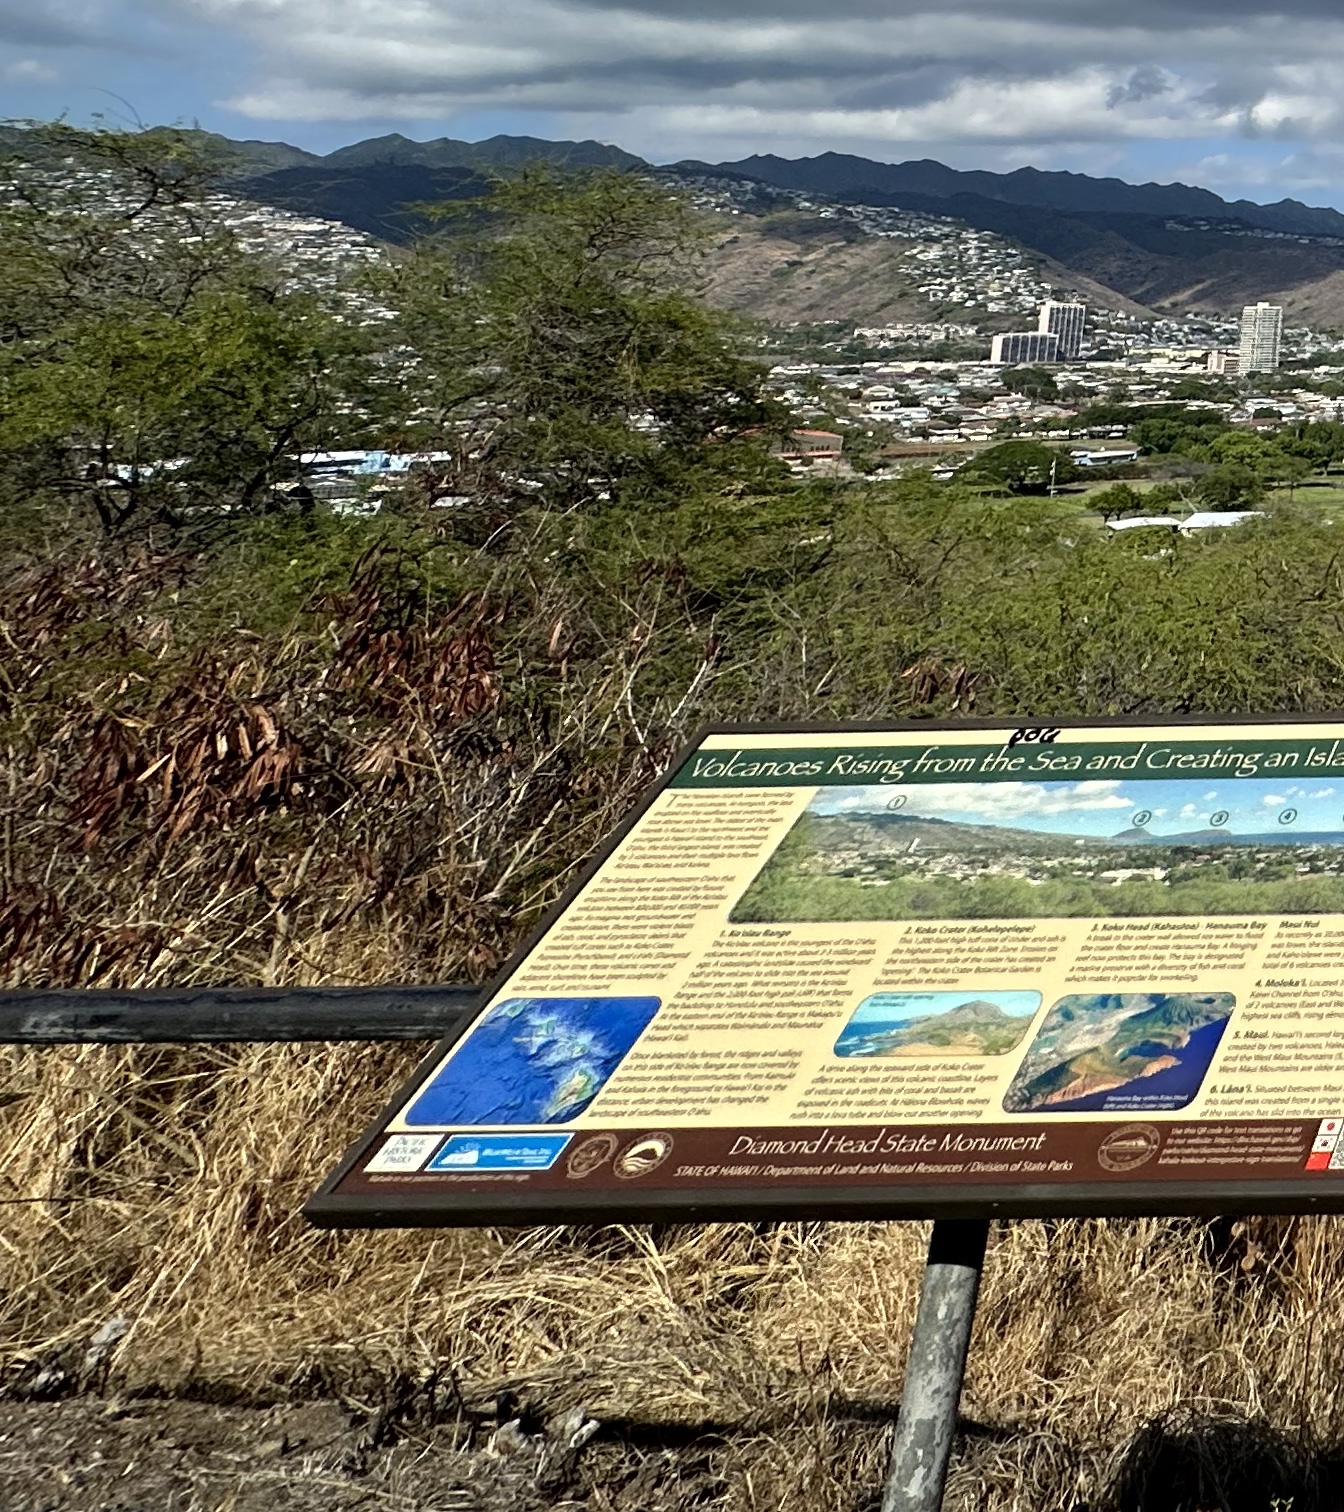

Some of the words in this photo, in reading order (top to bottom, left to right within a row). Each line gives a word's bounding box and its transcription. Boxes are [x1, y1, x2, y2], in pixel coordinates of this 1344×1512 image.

[692, 750, 824, 777] Volcanoes
[826, 753, 912, 783] Rising
[911, 745, 976, 773] from
[979, 744, 1026, 772] the
[1028, 750, 1082, 771] Sea
[1085, 742, 1147, 770] and
[1145, 746, 1264, 777] Creating
[1263, 752, 1299, 767] an
[1100, 923, 1125, 932] Koko
[1124, 922, 1151, 931] Head
[1249, 920, 1268, 931] Bay
[1278, 920, 1303, 929] Maui
[1302, 919, 1321, 928] Nui
[761, 929, 792, 939] Range
[913, 926, 938, 935] Koko
[938, 925, 967, 934] Crater
[1238, 1053, 1253, 1062] the
[1208, 1108, 1223, 1117] the
[1302, 1108, 1316, 1116] the
[728, 1128, 829, 1155] Diamond
[821, 1127, 886, 1153] Head
[879, 1134, 937, 1153] State
[938, 1132, 1046, 1151] Monument
[673, 1165, 705, 1176] STATE
[703, 1164, 720, 1176] OF
[762, 1164, 823, 1177] Department
[822, 1163, 836, 1175] of
[833, 1163, 861, 1175] Land
[858, 1163, 881, 1174] and
[879, 1162, 917, 1174] Natural
[915, 1162, 964, 1173] Resources
[969, 1161, 1009, 1172] Division
[1009, 1160, 1023, 1172] of
[1020, 1161, 1047, 1171] State
[1047, 1160, 1073, 1171] Parks
